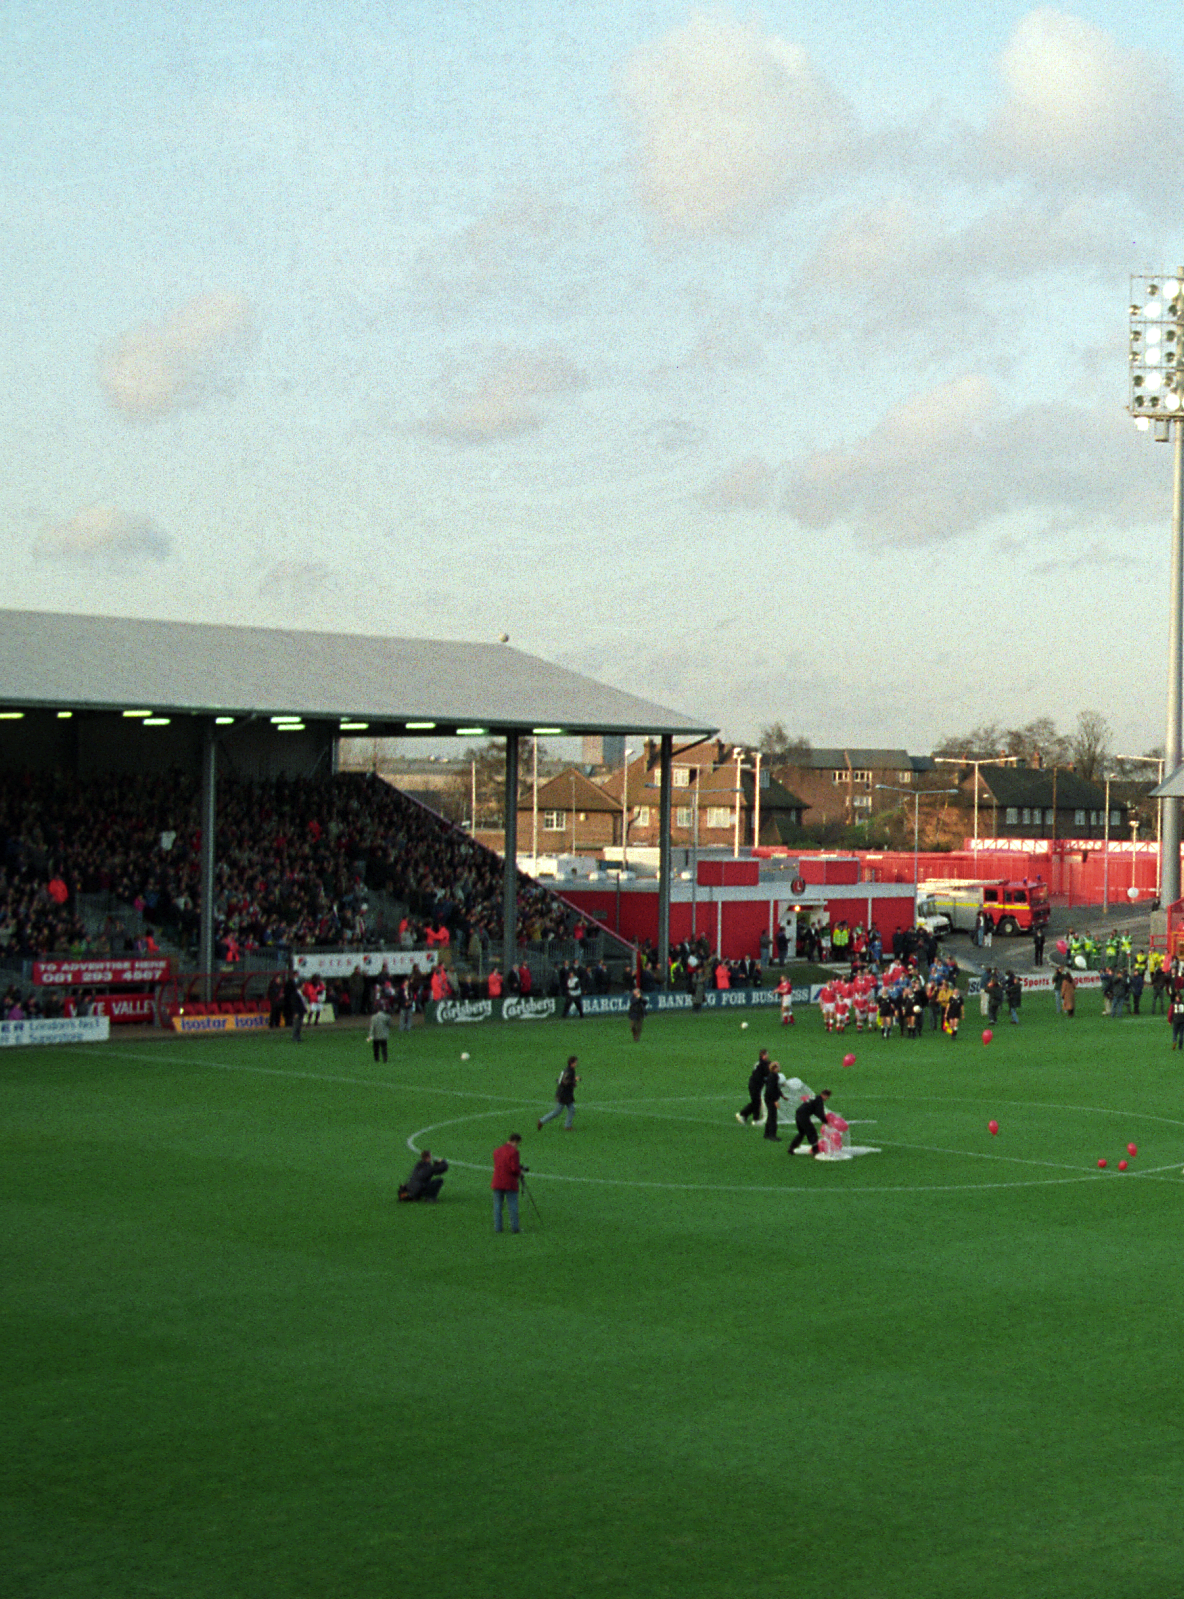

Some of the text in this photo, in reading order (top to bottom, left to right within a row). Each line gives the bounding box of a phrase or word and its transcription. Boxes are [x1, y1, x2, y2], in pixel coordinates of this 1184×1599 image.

[39, 960, 167, 972] TO ADVERTISE HERE
[42, 973, 73, 983] 081
[82, 971, 113, 981] 293
[658, 993, 716, 1008] BANKG
[722, 992, 746, 1005] FOR
[436, 997, 556, 1023] Carlsberg Carlsberg
[181, 1017, 226, 1030] isostar
